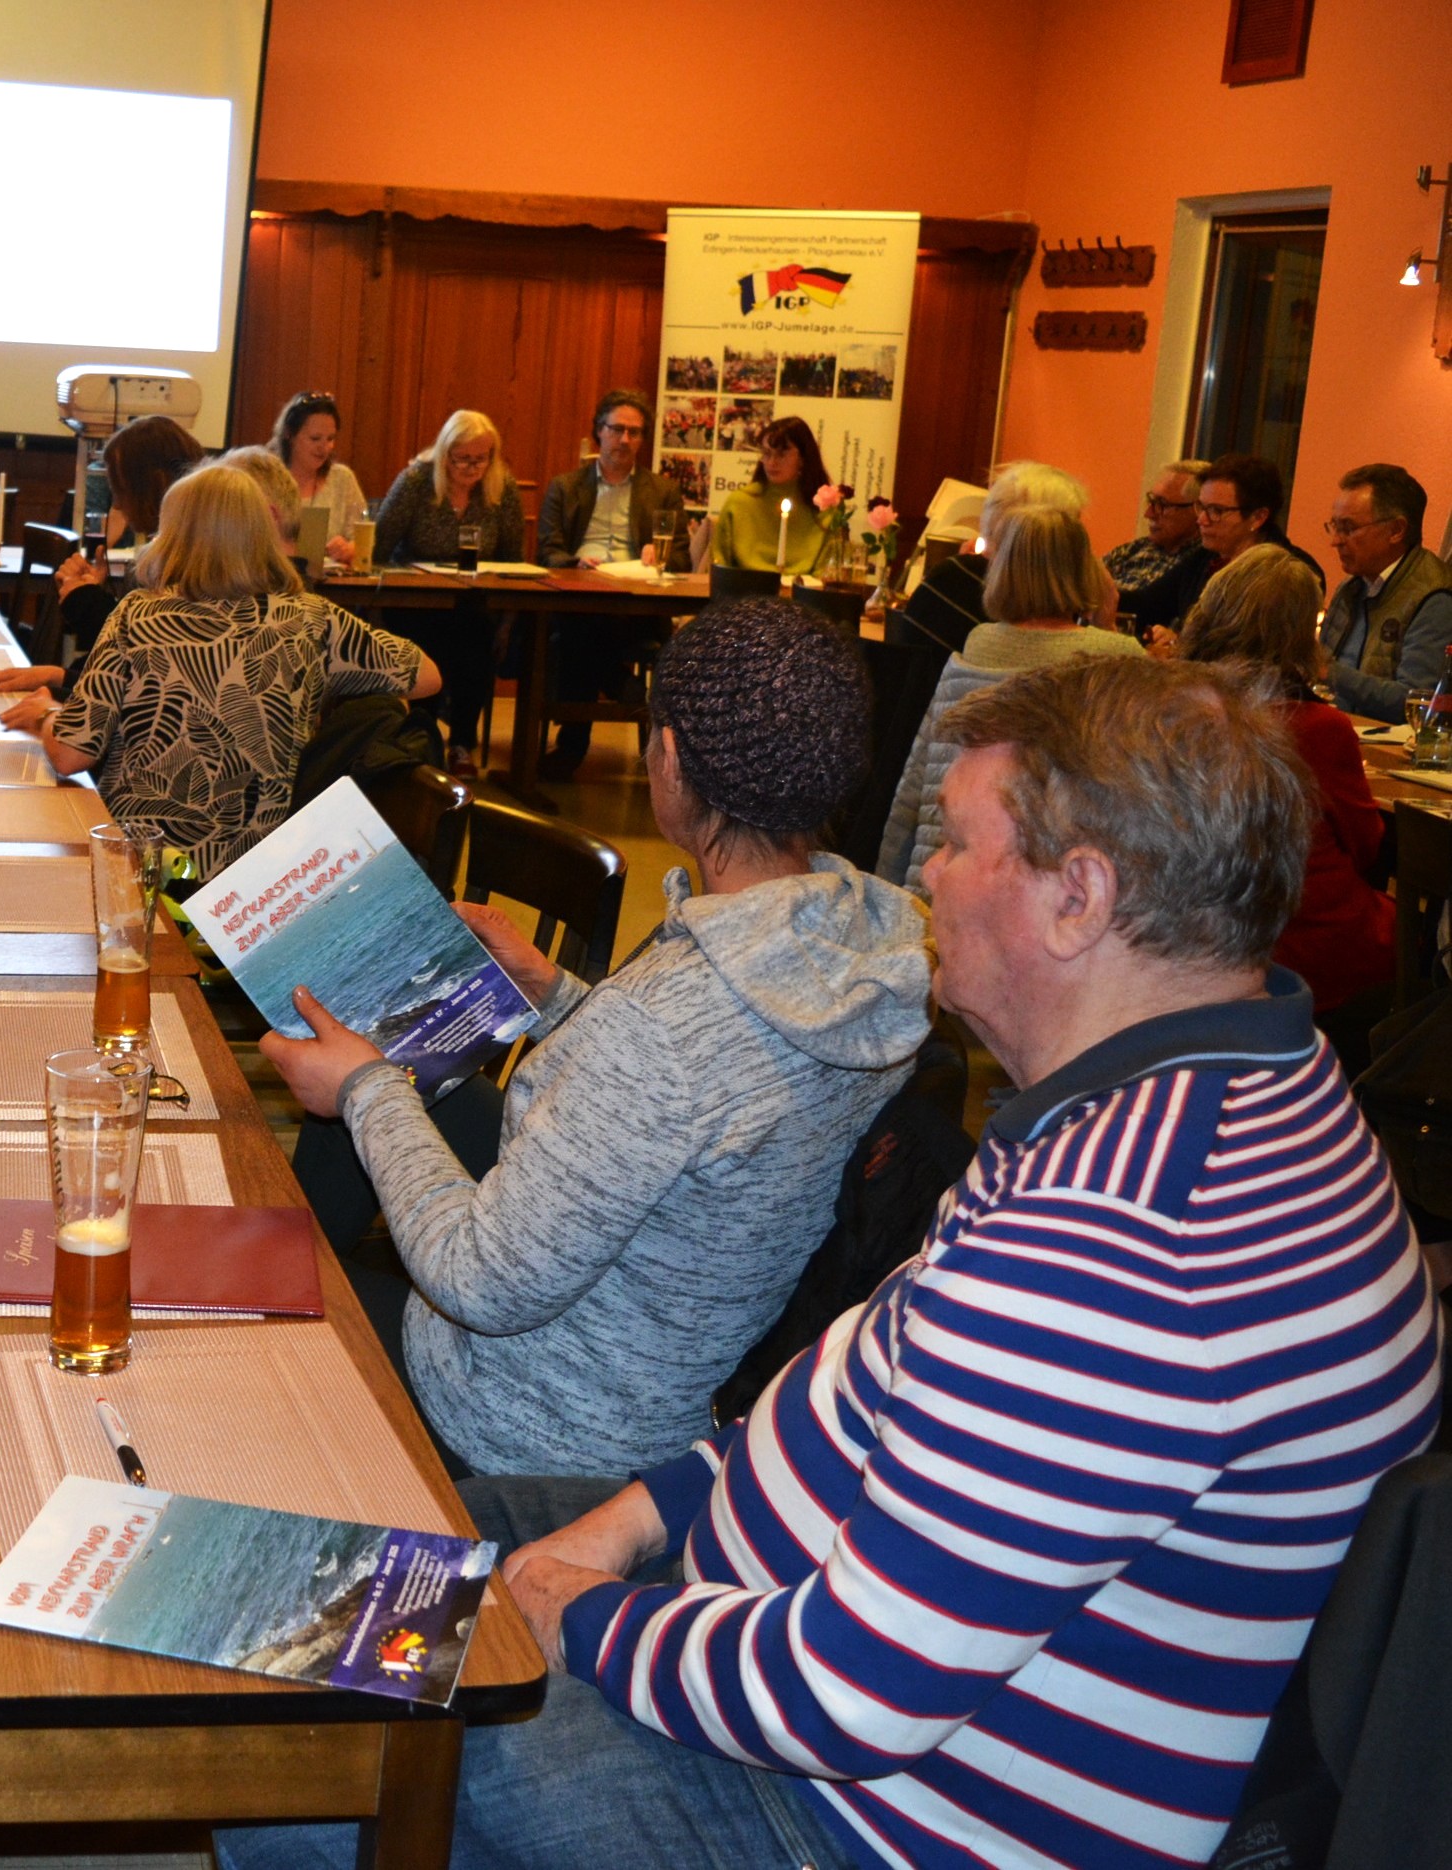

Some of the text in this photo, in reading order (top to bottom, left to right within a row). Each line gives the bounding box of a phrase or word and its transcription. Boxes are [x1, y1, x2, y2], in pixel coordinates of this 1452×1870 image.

[774, 296, 810, 311] IGP
[208, 890, 243, 919] VOM
[222, 847, 330, 936] NECKARSTRAND
[234, 922, 270, 953] ZUM
[269, 891, 308, 926] ABER
[3, 1227, 40, 1267] Speisen
[4, 1581, 41, 1607] VOM
[36, 1525, 111, 1613] NECKARSTRAND
[66, 1591, 104, 1620] ZUM
[87, 1559, 124, 1591] ABER
